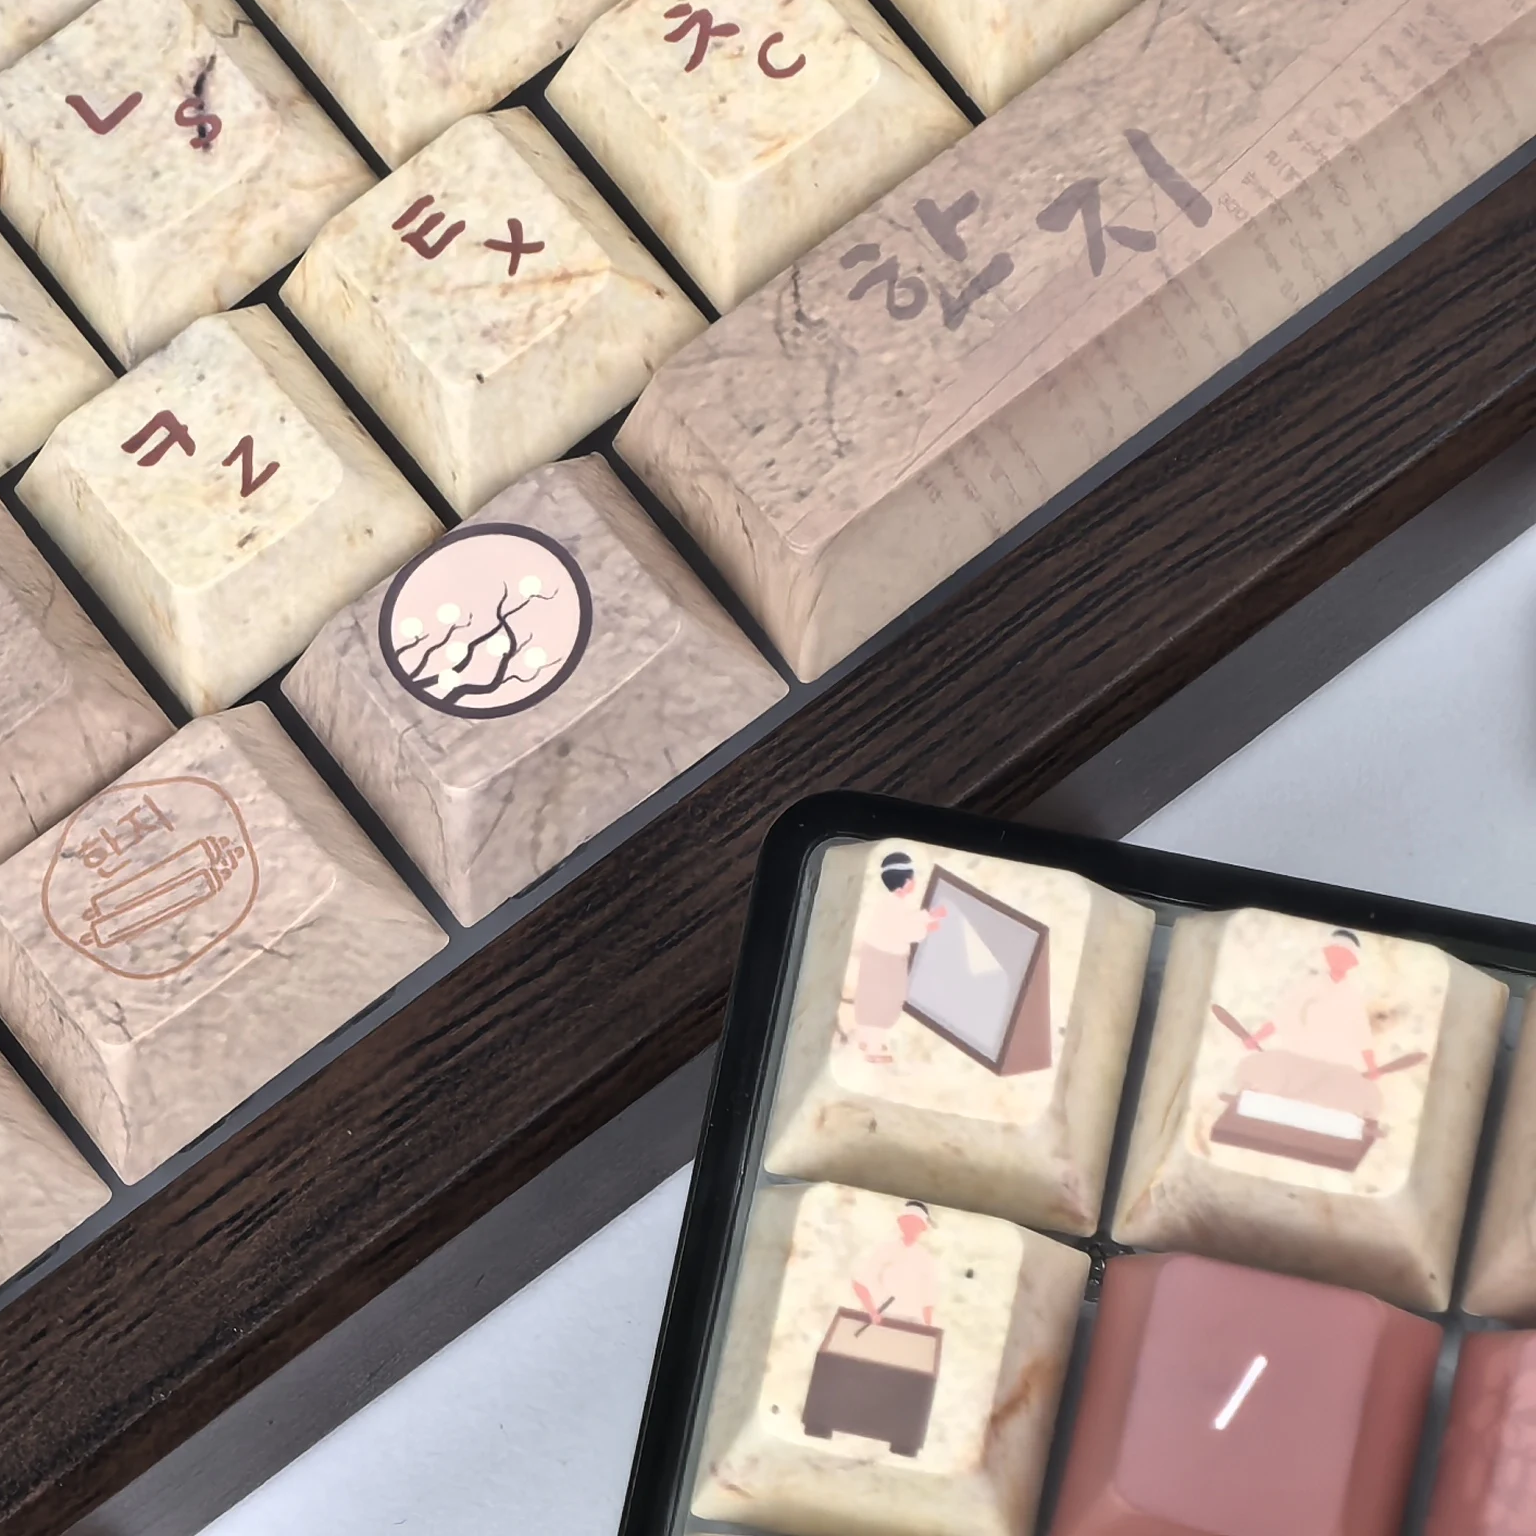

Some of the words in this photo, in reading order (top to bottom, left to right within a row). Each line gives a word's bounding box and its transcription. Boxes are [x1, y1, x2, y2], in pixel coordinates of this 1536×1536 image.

[758, 32, 806, 79] C
[175, 98, 222, 150] S
[484, 219, 544, 276] X
[223, 436, 279, 498] Z
